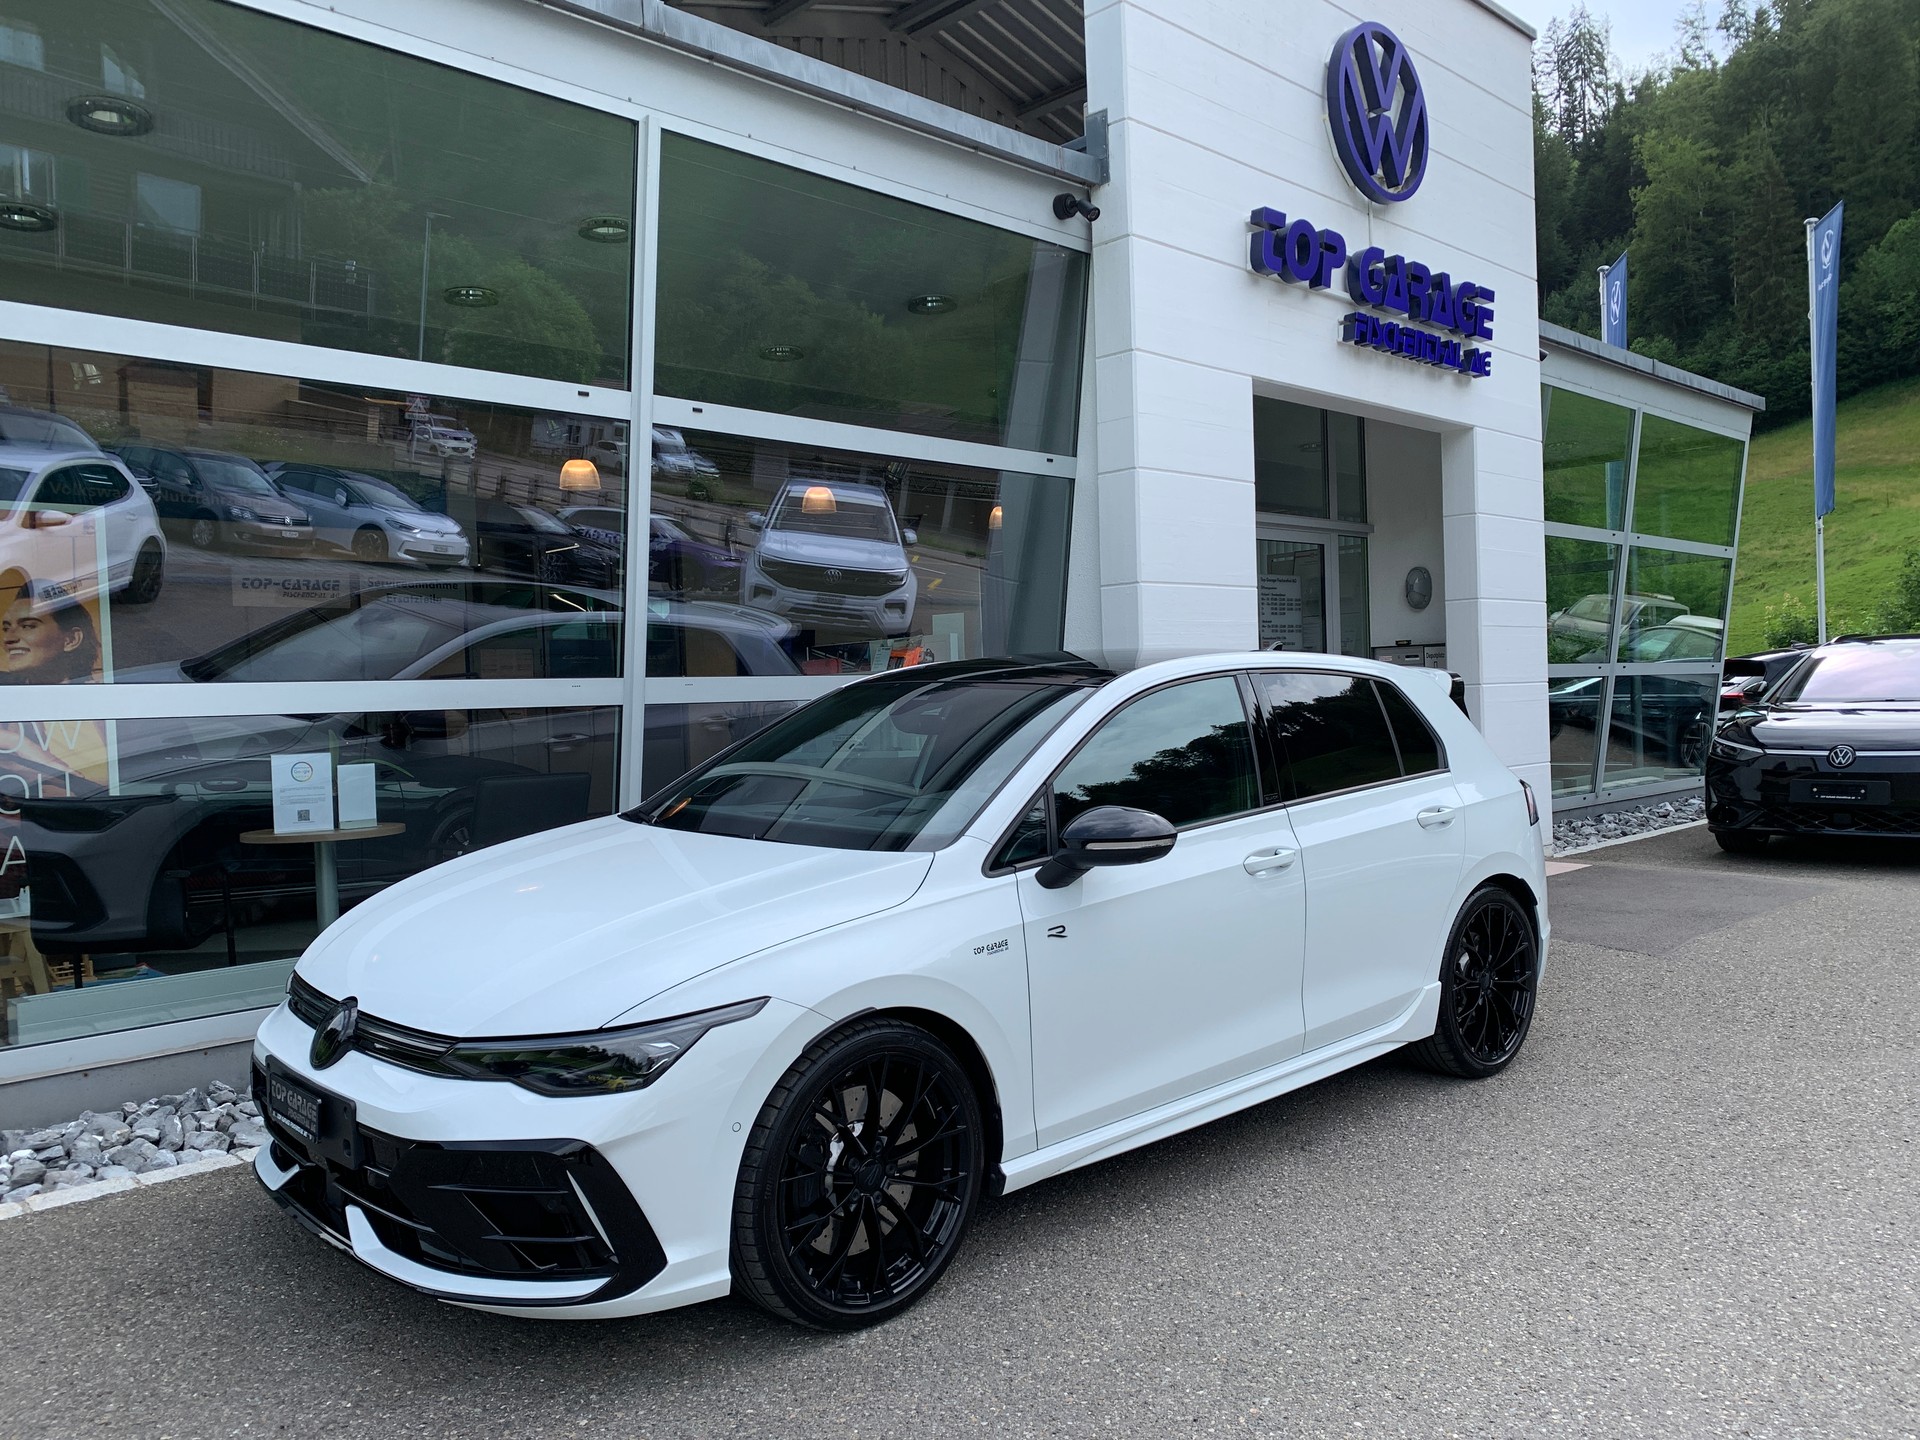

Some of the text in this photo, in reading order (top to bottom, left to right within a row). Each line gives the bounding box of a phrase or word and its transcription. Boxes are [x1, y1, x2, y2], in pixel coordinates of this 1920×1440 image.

[1250, 206, 1495, 341] TOP GARAGE
[1460, 348, 1492, 377] AG
[973, 938, 1009, 955] TOP GARAGE
[271, 1080, 317, 1123] TOP GARAGE
